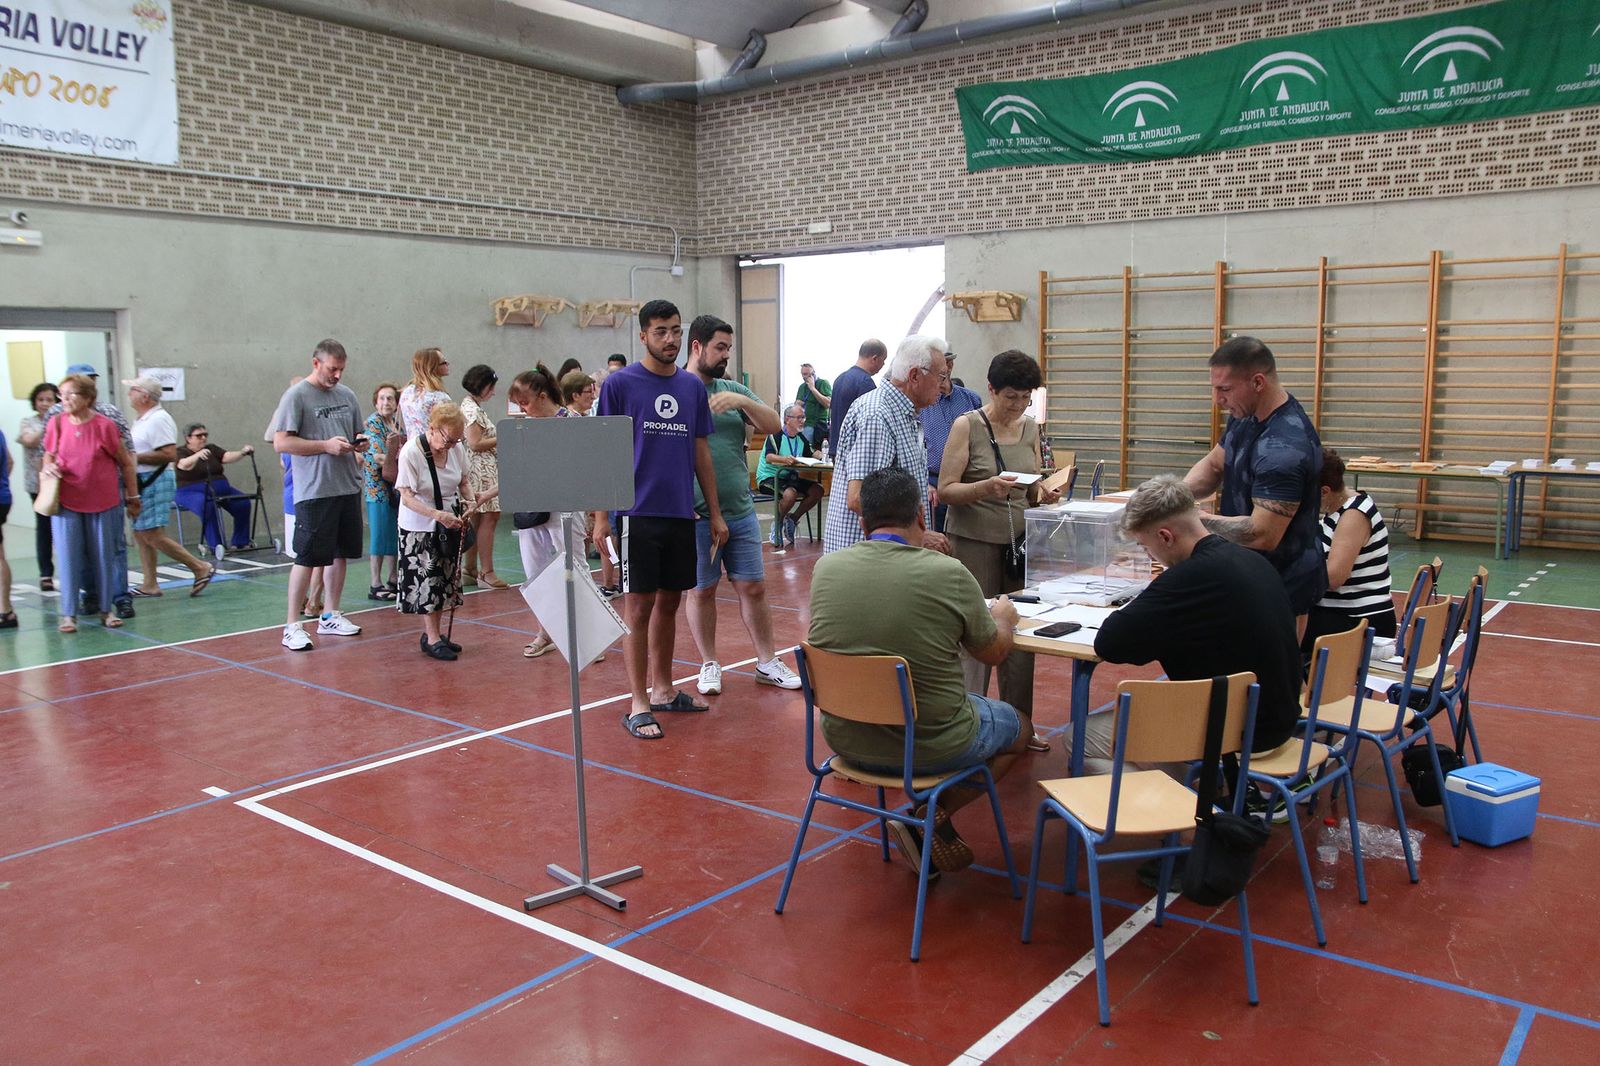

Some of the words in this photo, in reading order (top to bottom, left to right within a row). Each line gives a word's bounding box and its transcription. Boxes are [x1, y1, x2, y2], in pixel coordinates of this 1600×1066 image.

[0, 6, 39, 43] RIA
[51, 16, 147, 62] VOLLEY
[49, 75, 118, 108] 2008
[1398, 89, 1429, 103] JUNTA
[1433, 87, 1445, 99] DE
[1239, 108, 1266, 122] JUNTA
[1269, 106, 1279, 117] DE
[1101, 133, 1125, 144] JUNTA
[1128, 131, 1137, 141] DE
[643, 421, 688, 432] PROPADEL
